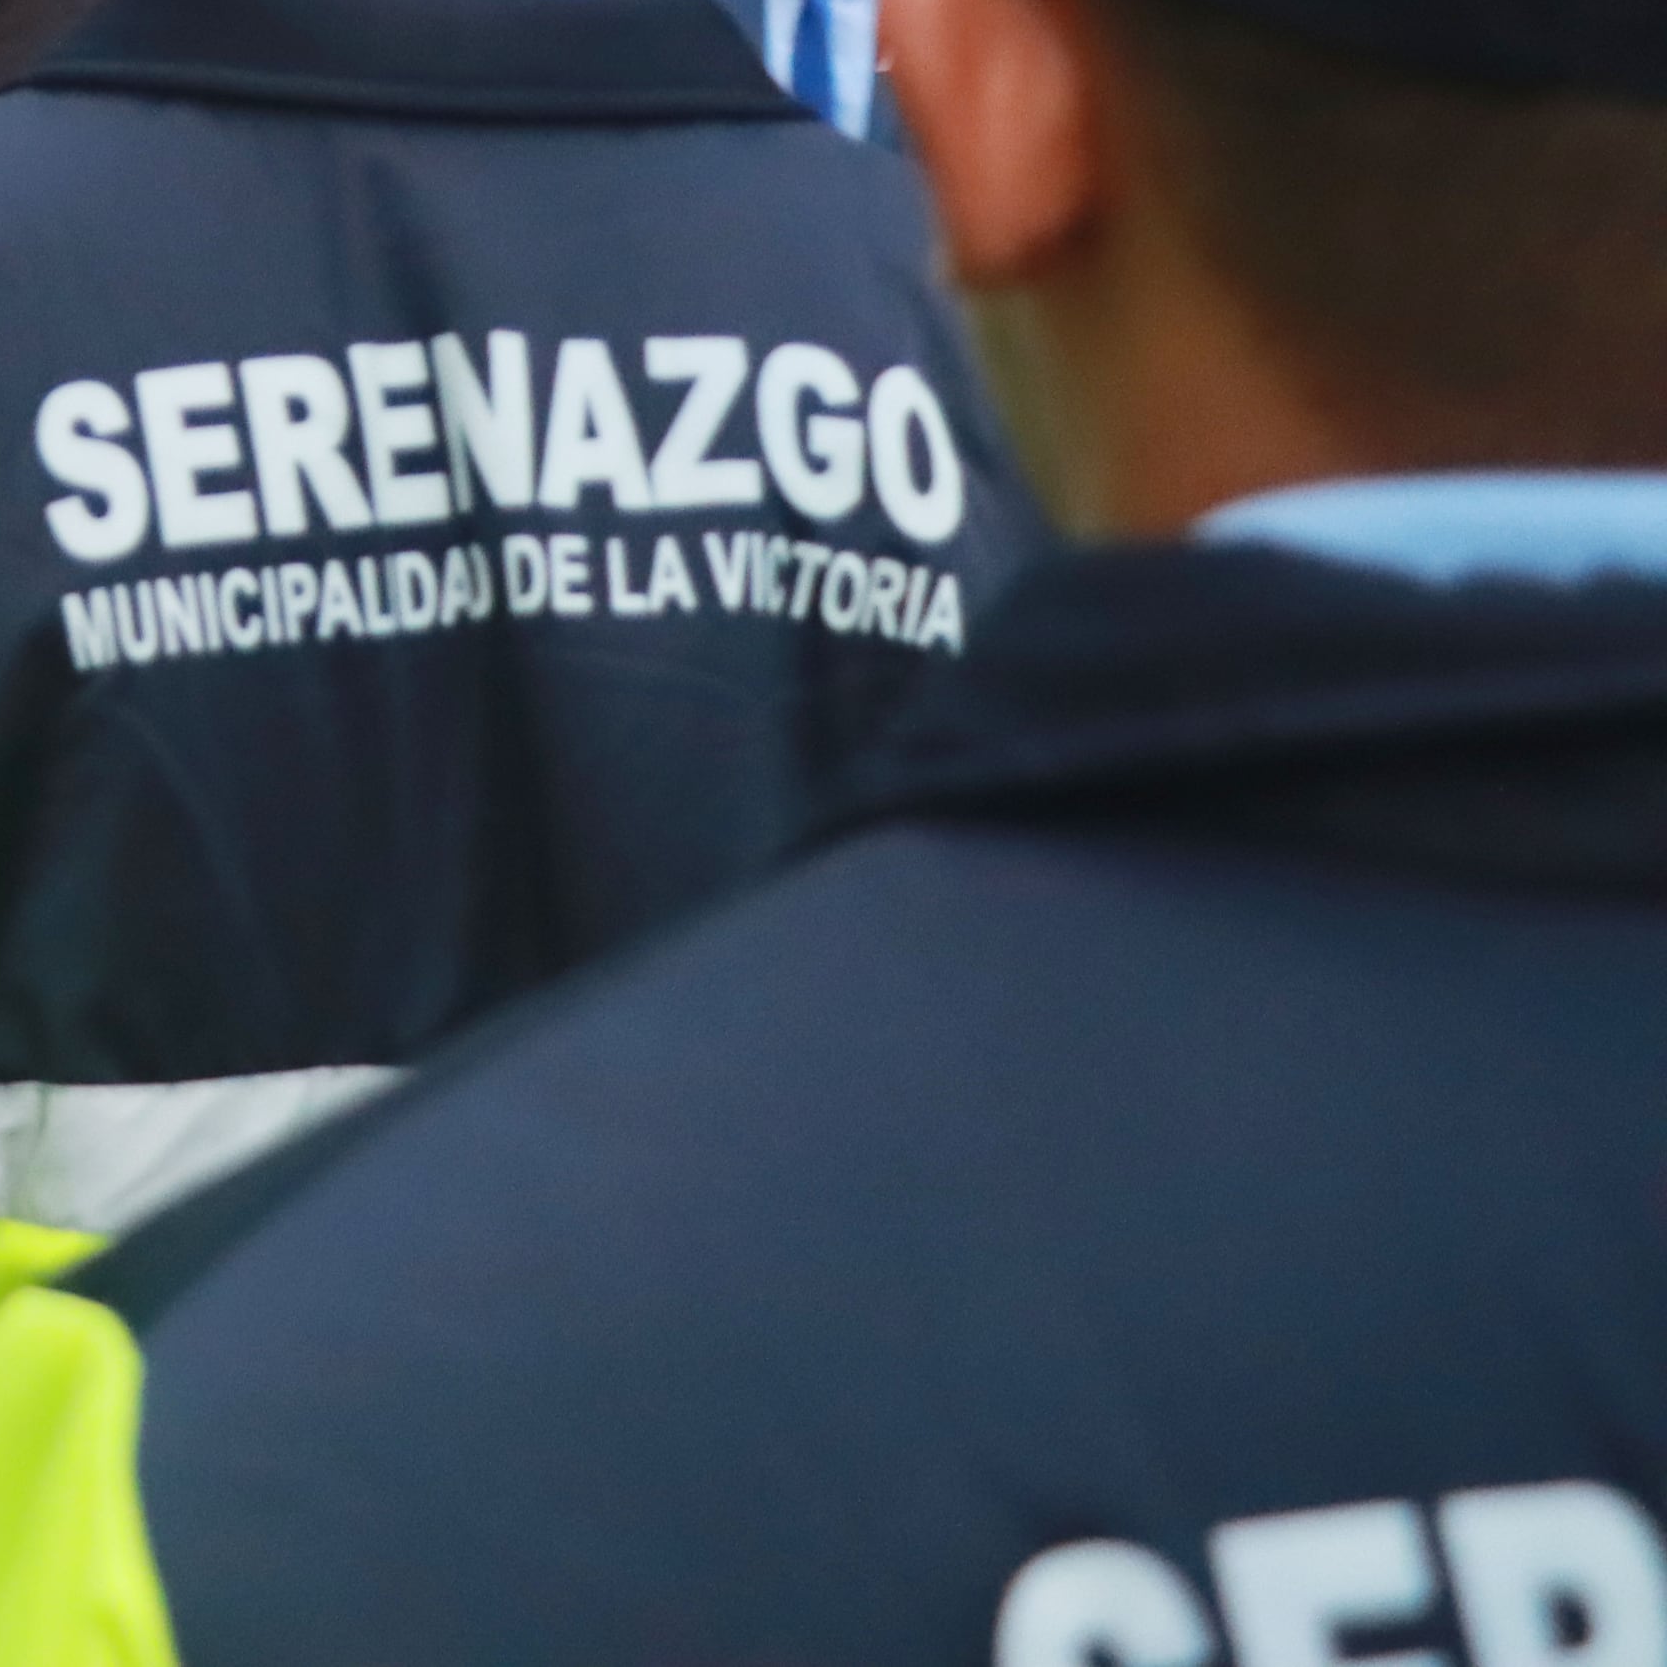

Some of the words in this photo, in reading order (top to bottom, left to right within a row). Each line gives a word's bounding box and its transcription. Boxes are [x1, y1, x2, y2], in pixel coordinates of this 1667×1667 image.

[34, 328, 965, 563] SERENAZGO
[502, 533, 593, 619] DE
[606, 533, 703, 618] LA
[704, 531, 964, 656] VICTORIA
